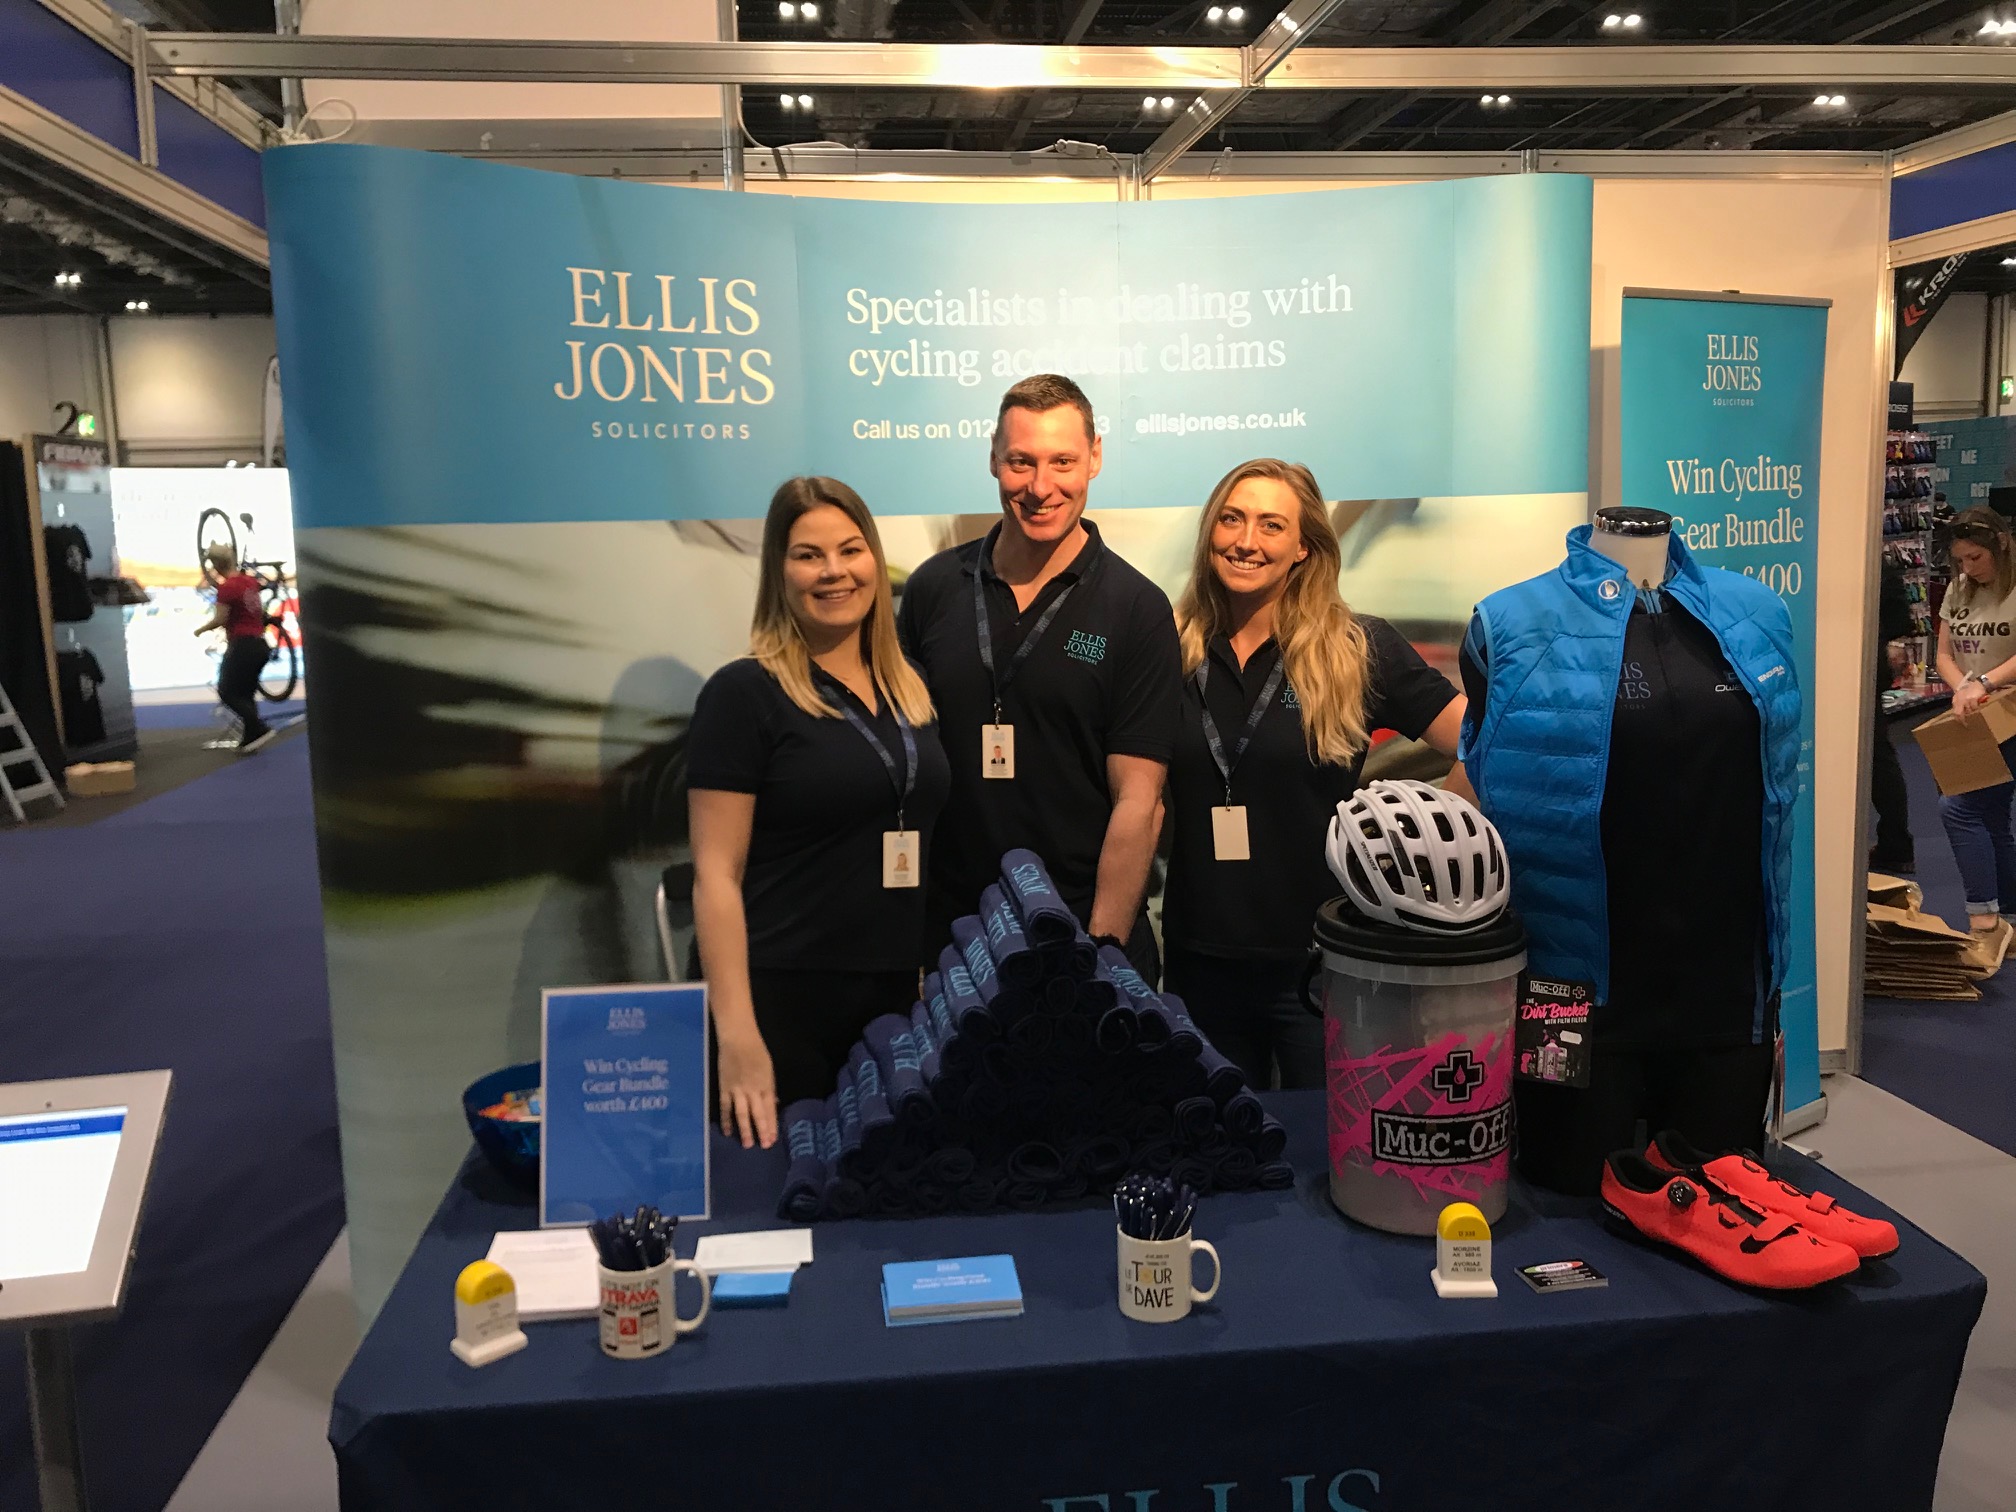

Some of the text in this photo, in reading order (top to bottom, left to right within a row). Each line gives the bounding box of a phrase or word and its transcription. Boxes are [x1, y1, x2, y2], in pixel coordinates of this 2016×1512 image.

[1919, 253, 1964, 305] KRO
[565, 267, 760, 336] ELLIS
[846, 275, 1352, 334] Specialists in dealing with
[848, 333, 1287, 387] cycling accident claims
[1707, 334, 1759, 361] ELLIS
[553, 340, 776, 405] JONES
[1703, 365, 1762, 391] JONES
[1713, 398, 1755, 406] SOLICITORS
[591, 421, 750, 440] SOLICITORS
[852, 408, 1307, 439] Call us on 012 ellisjones.co.uk
[1666, 455, 1803, 501] Win Cycling
[1671, 507, 1804, 550] Gear Bundle
[1063, 640, 1106, 660] JONES
[1070, 630, 1107, 648] ELLIS
[1067, 652, 1098, 665] SOLICITORS
[1011, 864, 1050, 896] JONES
[1532, 983, 1568, 995] Muc-Off
[1521, 1001, 1593, 1020] Dirt Bucket
[583, 1057, 669, 1075] Win Cycling
[582, 1075, 669, 1094] Gear Bundle
[583, 1096, 669, 1112] worth £400
[1382, 1108, 1509, 1157] Muc-Off
[1134, 1286, 1174, 1308] DAVE
